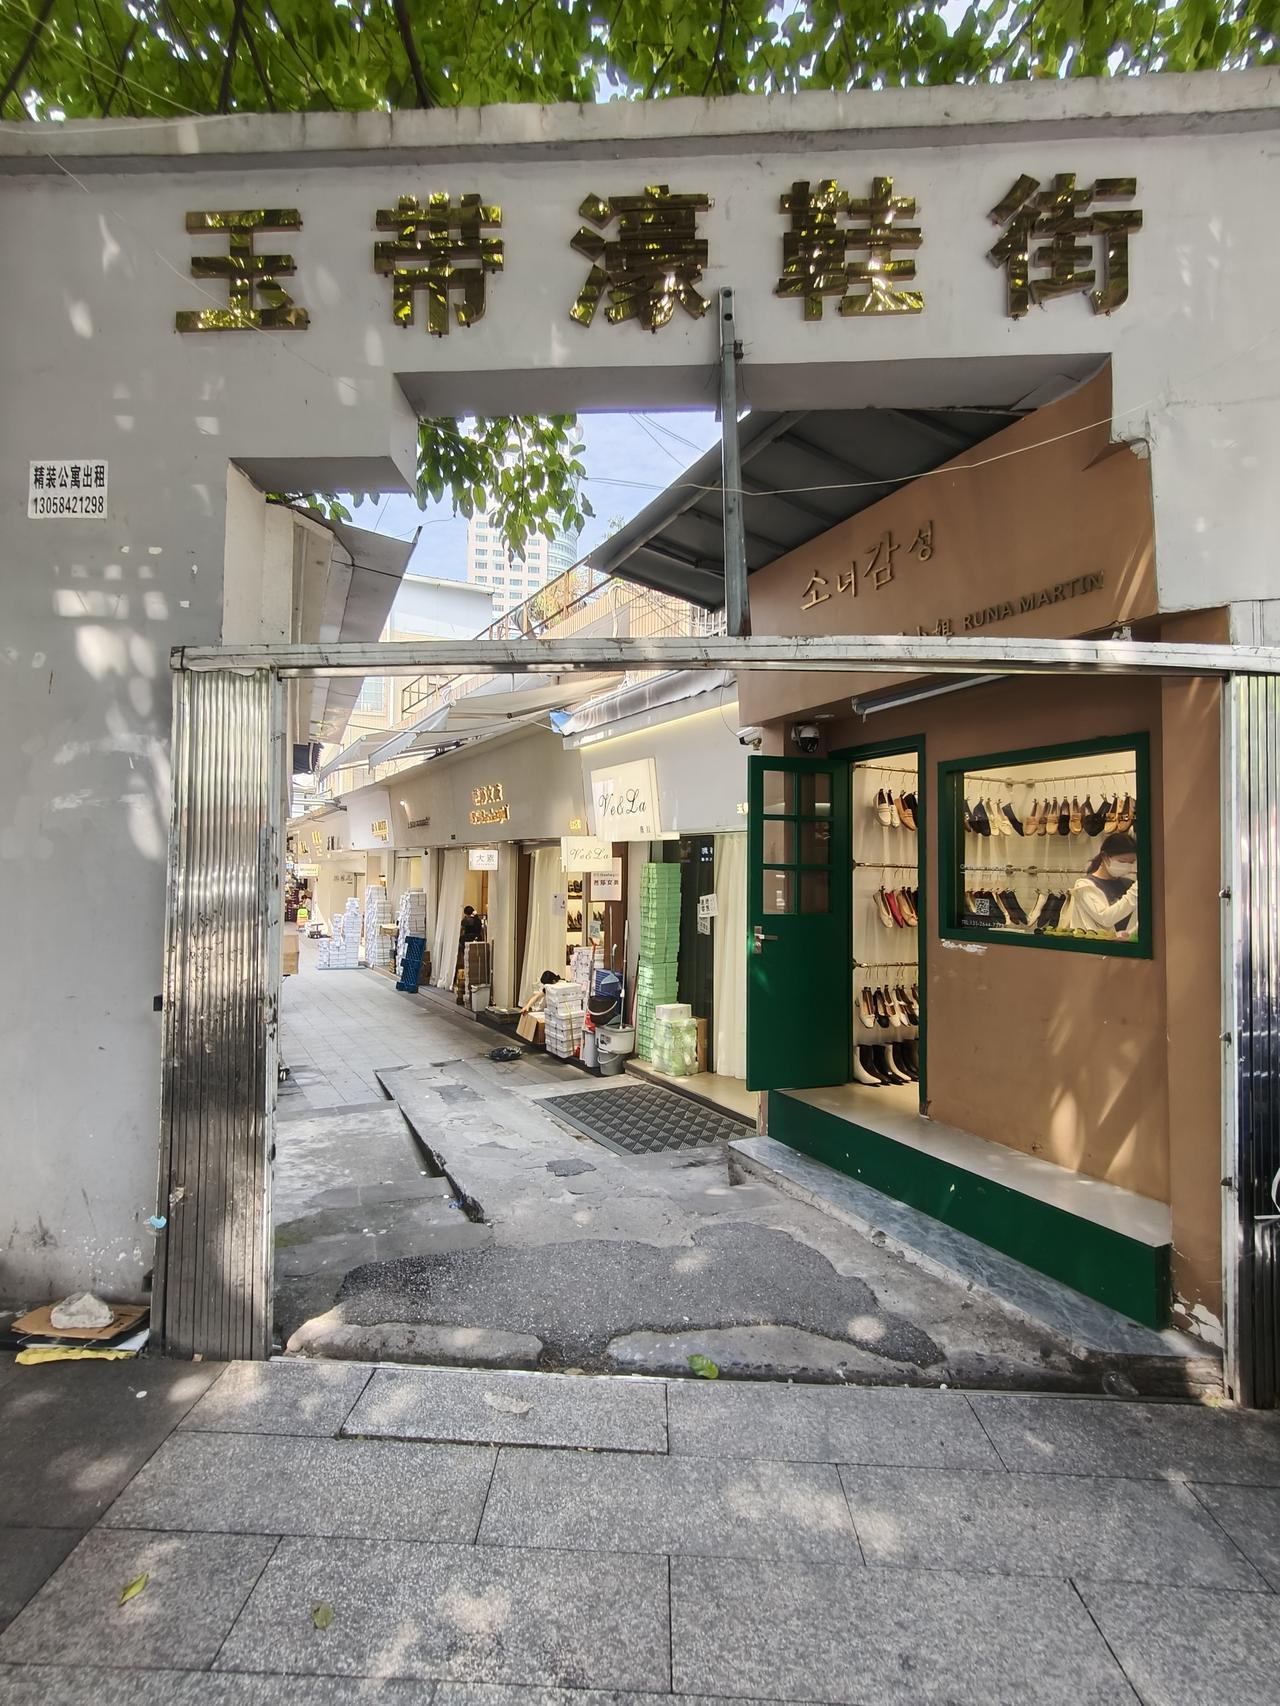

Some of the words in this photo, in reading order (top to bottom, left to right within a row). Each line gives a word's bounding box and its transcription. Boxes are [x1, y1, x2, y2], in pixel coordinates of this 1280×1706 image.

[176, 173, 1143, 335] 玉带濠鞋街
[33, 496, 104, 514] 13058421298
[34, 465, 105, 489] 精装公寓出租
[800, 519, 935, 611] 소녀감성
[962, 603, 1014, 631] RUNA
[1018, 569, 1105, 614] MARTIN
